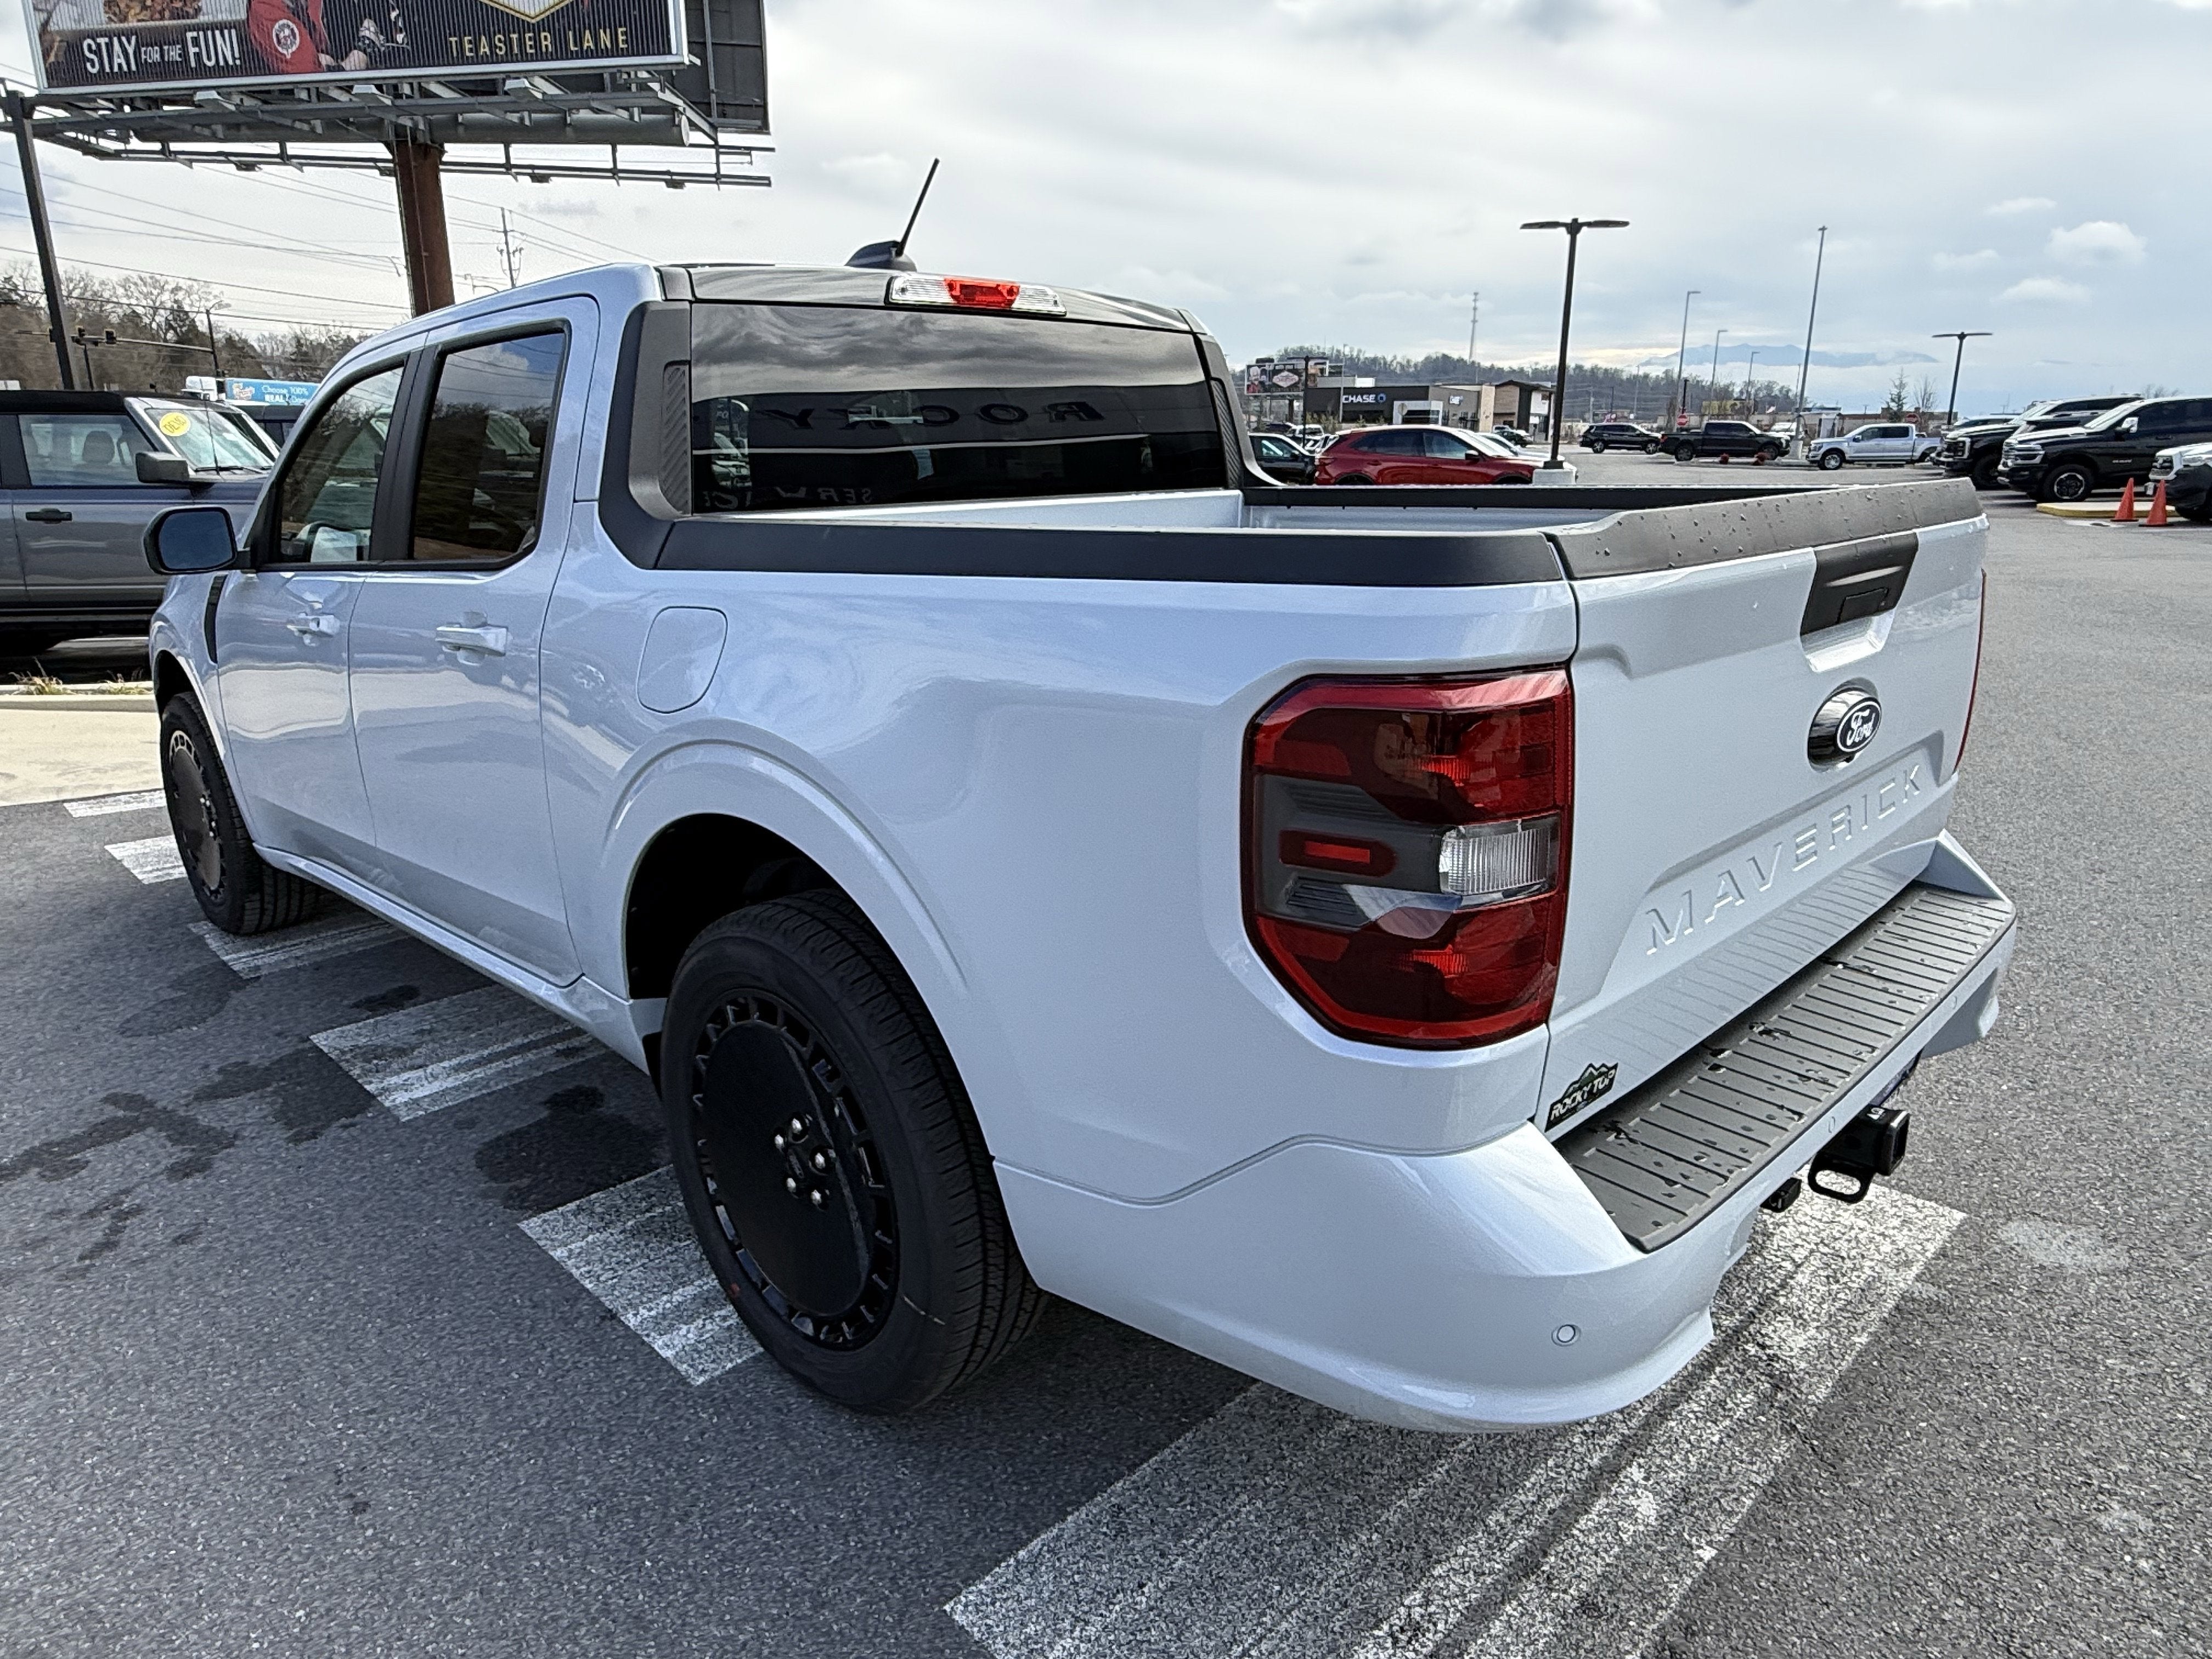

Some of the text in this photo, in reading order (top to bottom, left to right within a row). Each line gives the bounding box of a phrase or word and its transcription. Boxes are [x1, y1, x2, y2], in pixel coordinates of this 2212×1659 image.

[83, 29, 240, 74] STAY FOR THE FUN!
[449, 27, 628, 57] TEASTER LANE
[262, 385, 288, 394] Choose
[1342, 394, 1376, 403] CHASE
[1847, 709, 1875, 746] Ford
[1646, 764, 1921, 956] MAVERICK
[1550, 1069, 1616, 1120] ROCKY TOP
